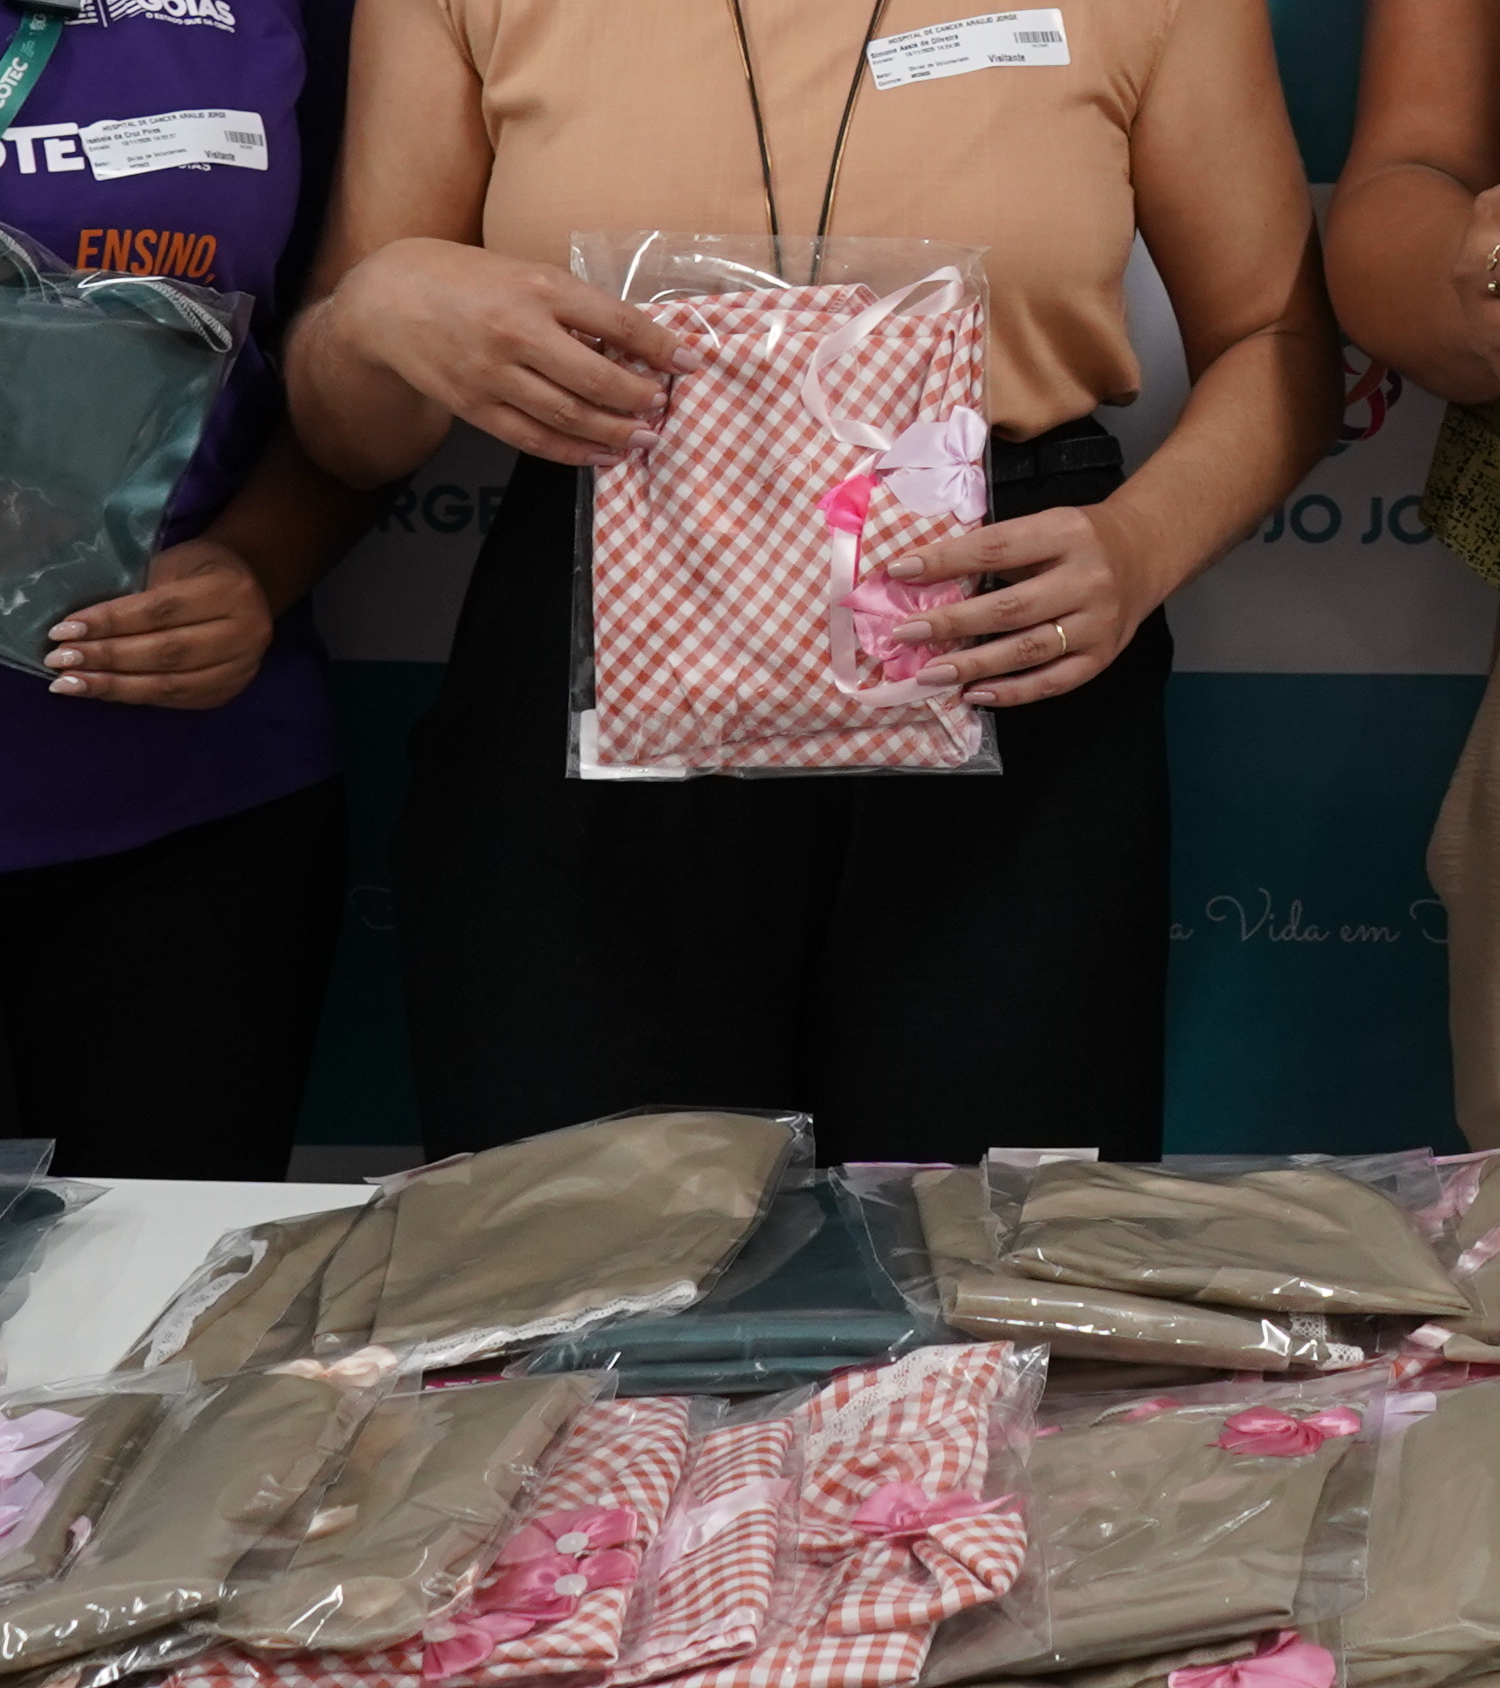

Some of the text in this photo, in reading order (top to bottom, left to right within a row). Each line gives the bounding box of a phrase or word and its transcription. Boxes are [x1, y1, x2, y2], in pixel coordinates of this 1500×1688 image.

[988, 54, 1025, 63] Visitante
[1205, 887, 1331, 942] Vida
[1339, 923, 1400, 943] em
